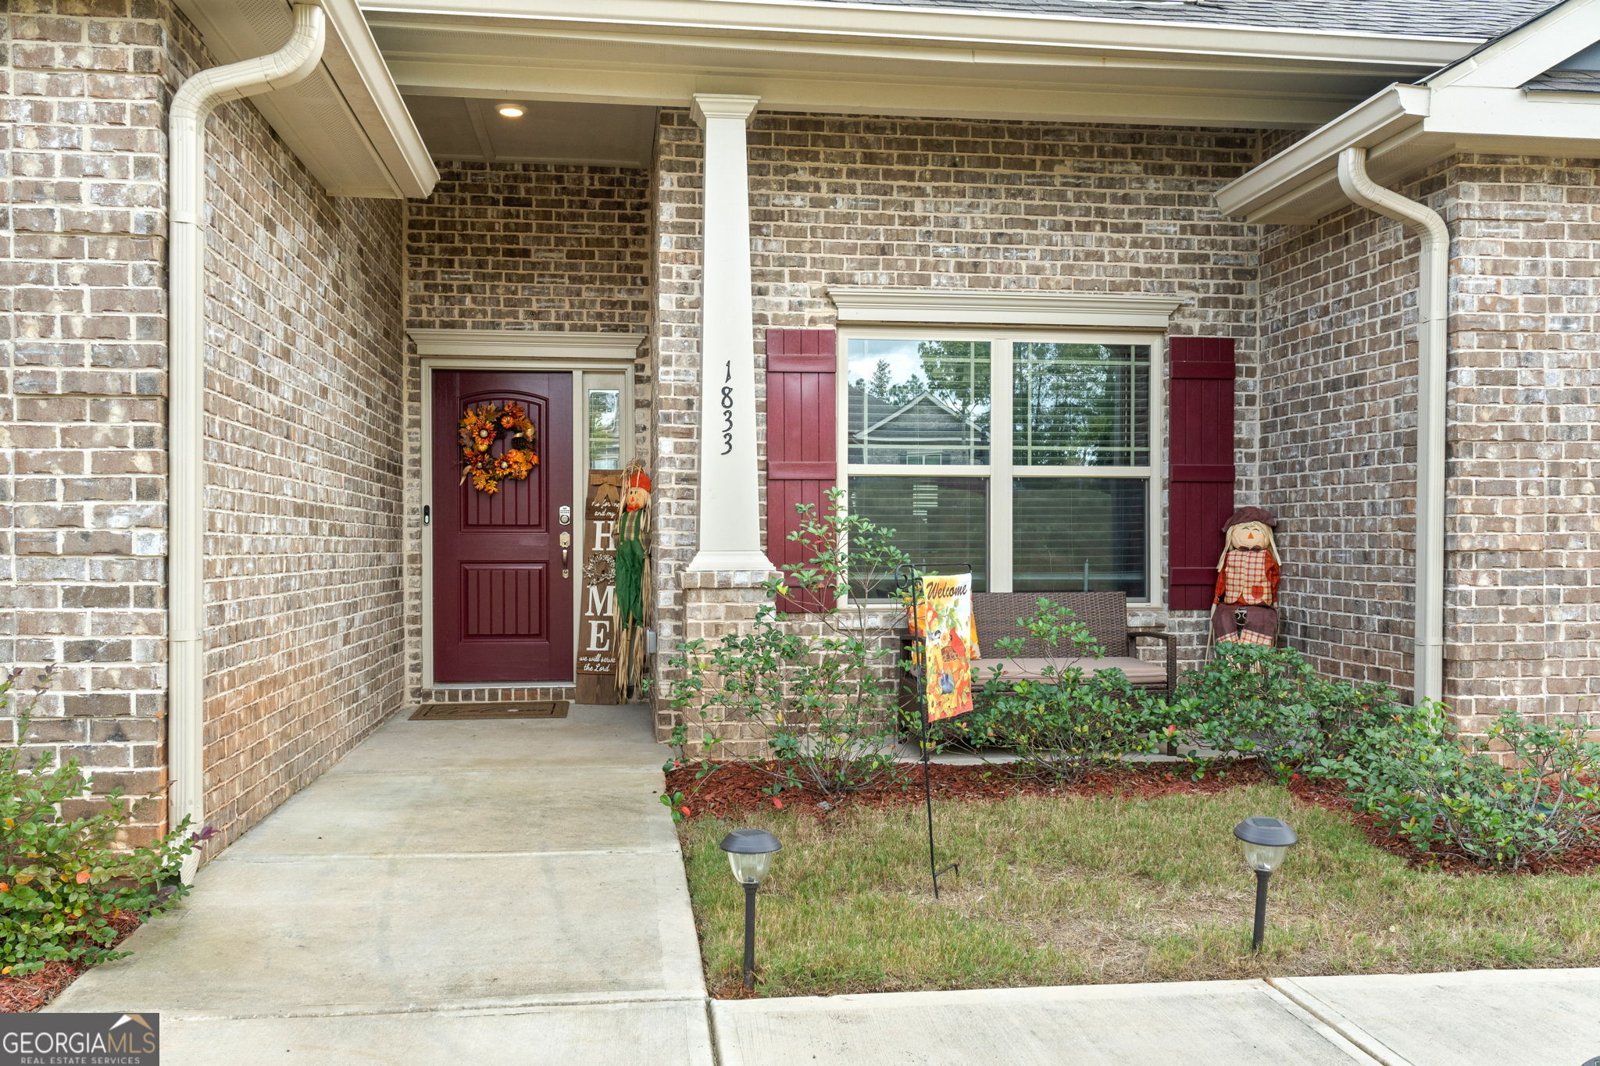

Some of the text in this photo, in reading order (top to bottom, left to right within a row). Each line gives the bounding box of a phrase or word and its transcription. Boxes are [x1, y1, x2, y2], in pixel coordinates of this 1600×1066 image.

[720, 359, 734, 455] 1833
[594, 508, 616, 519] and my
[926, 581, 968, 600] Welcome
[588, 653, 601, 662] will
[583, 662, 610, 672] the Lord
